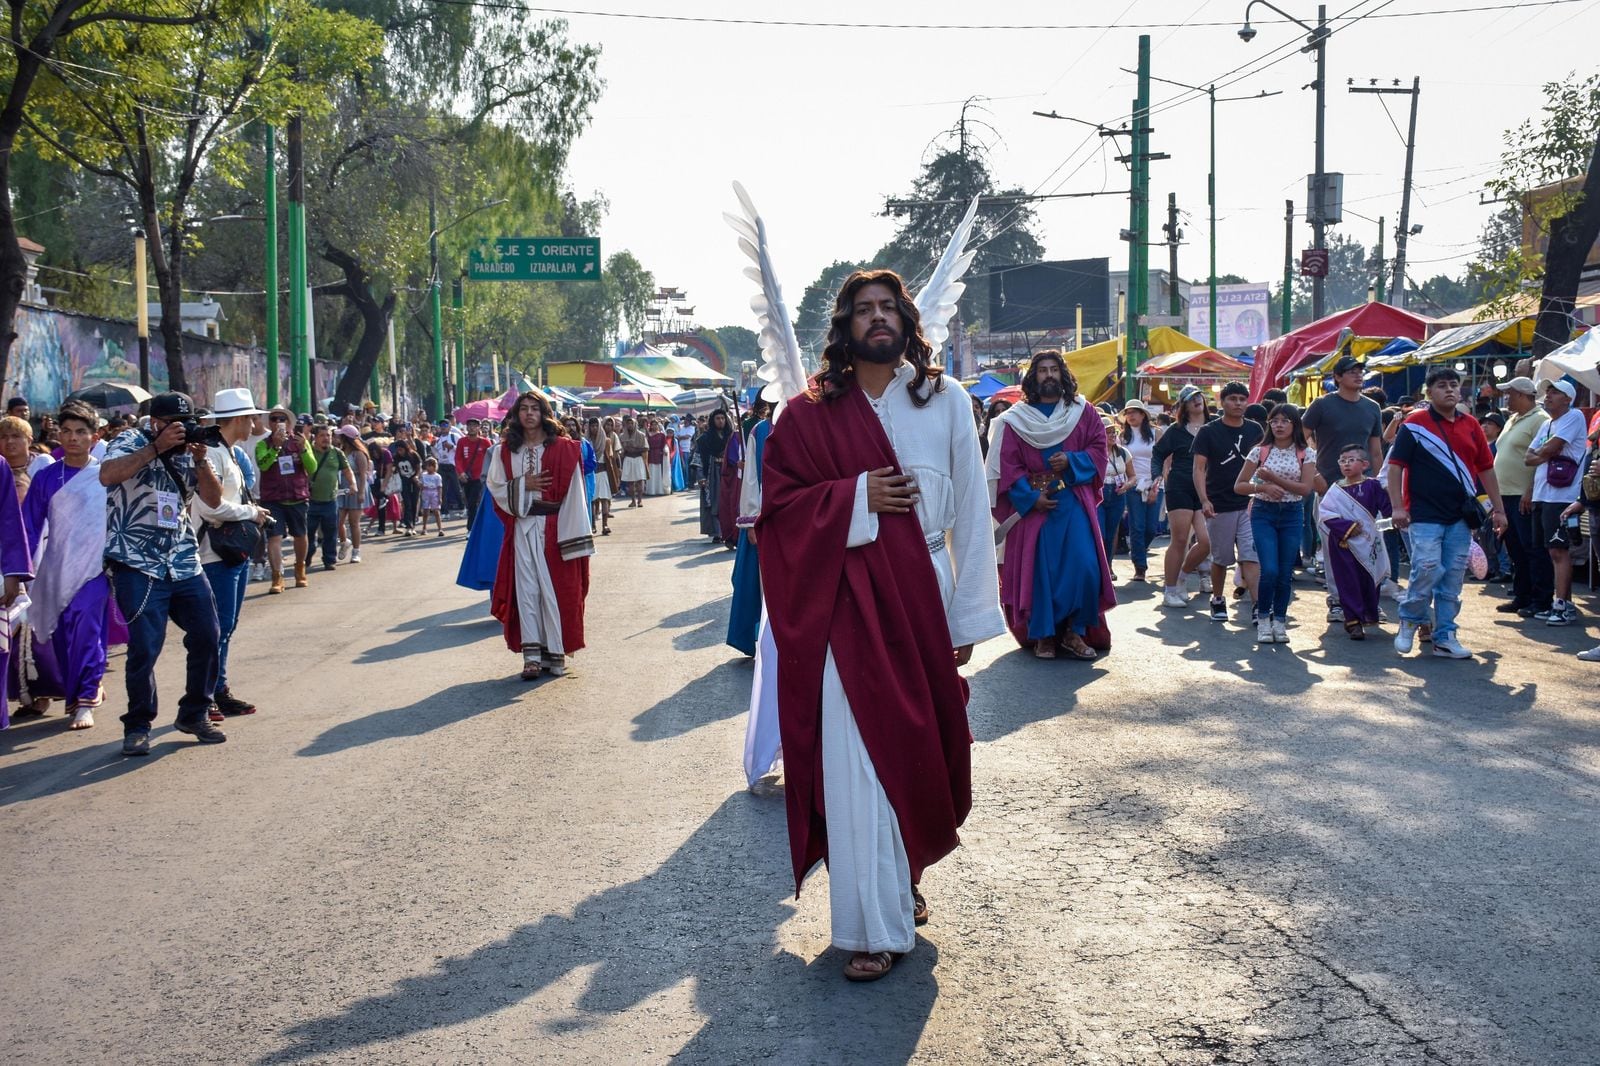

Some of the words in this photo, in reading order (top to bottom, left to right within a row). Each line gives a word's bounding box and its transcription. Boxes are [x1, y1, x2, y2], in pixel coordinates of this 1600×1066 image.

[495, 245, 520, 256] EJE
[527, 245, 536, 256] 3
[541, 245, 594, 256] ORIENTE
[474, 262, 515, 273] PARADERO
[530, 262, 577, 273] IZTAPALAPA
